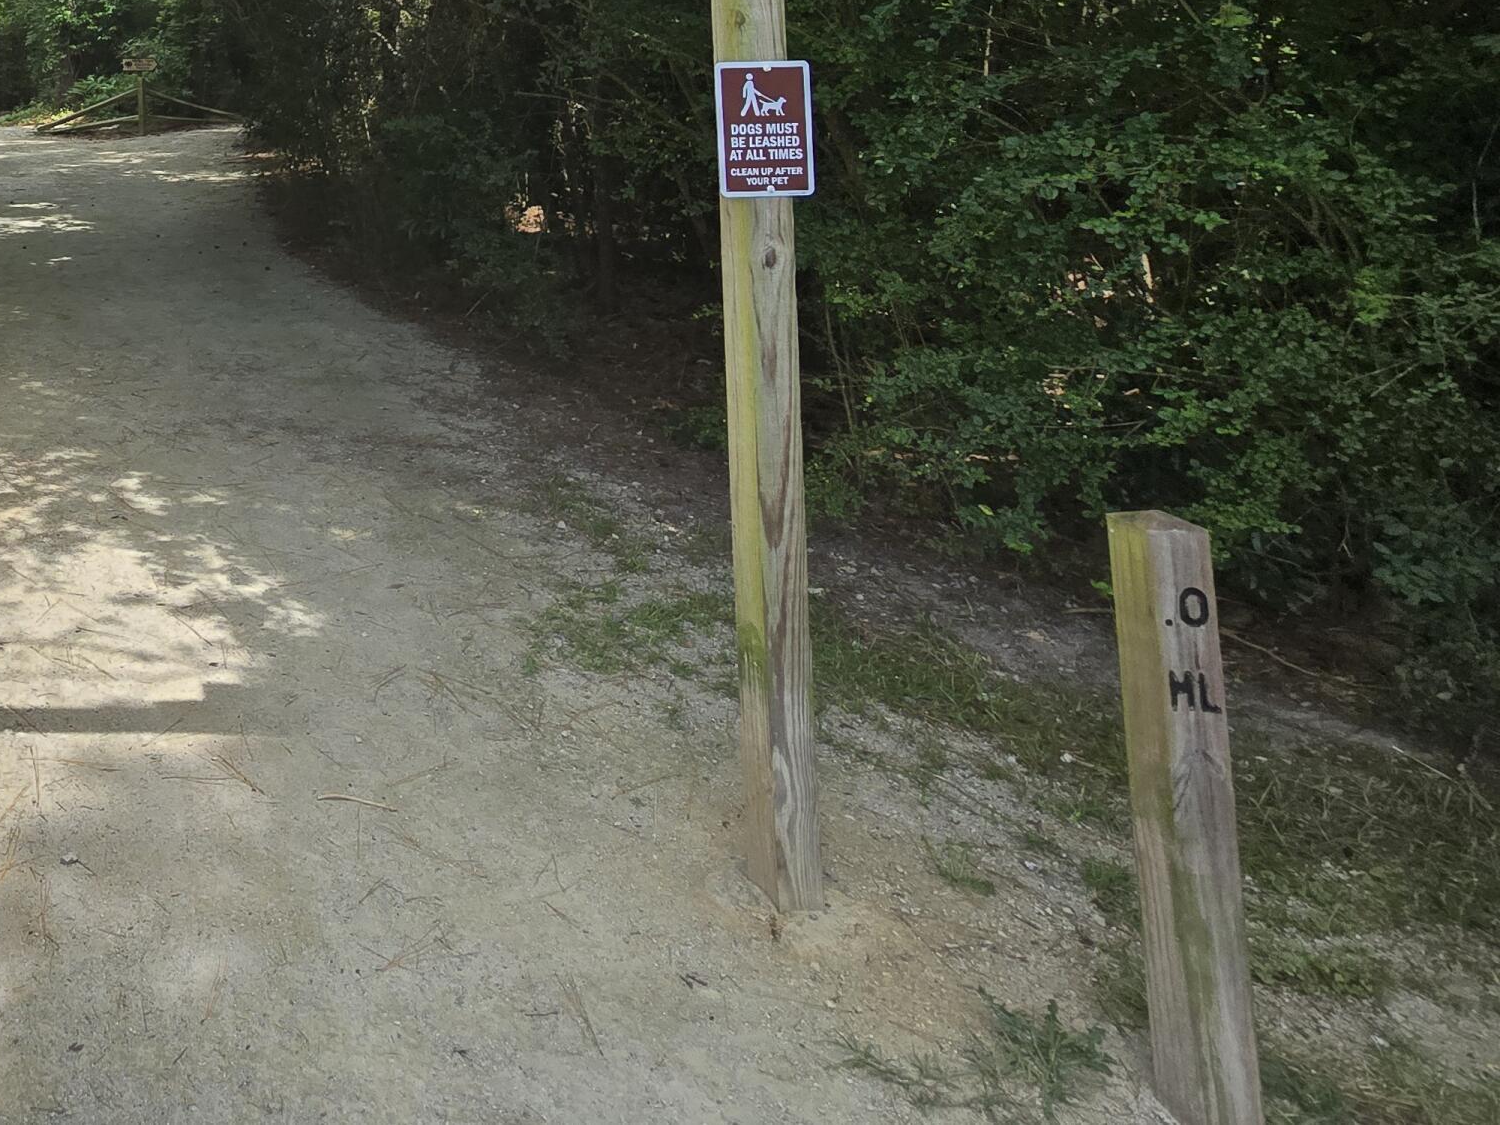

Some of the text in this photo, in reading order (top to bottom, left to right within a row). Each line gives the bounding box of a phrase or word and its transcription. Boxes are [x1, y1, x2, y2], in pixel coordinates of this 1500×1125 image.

[731, 122, 799, 135] DOGS MUST
[731, 136, 800, 148] BE LEASHED
[729, 148, 804, 161] AT ALL TIMES
[730, 167, 803, 176] CLEAN UP AFTER
[746, 177, 789, 186] YOUR PET
